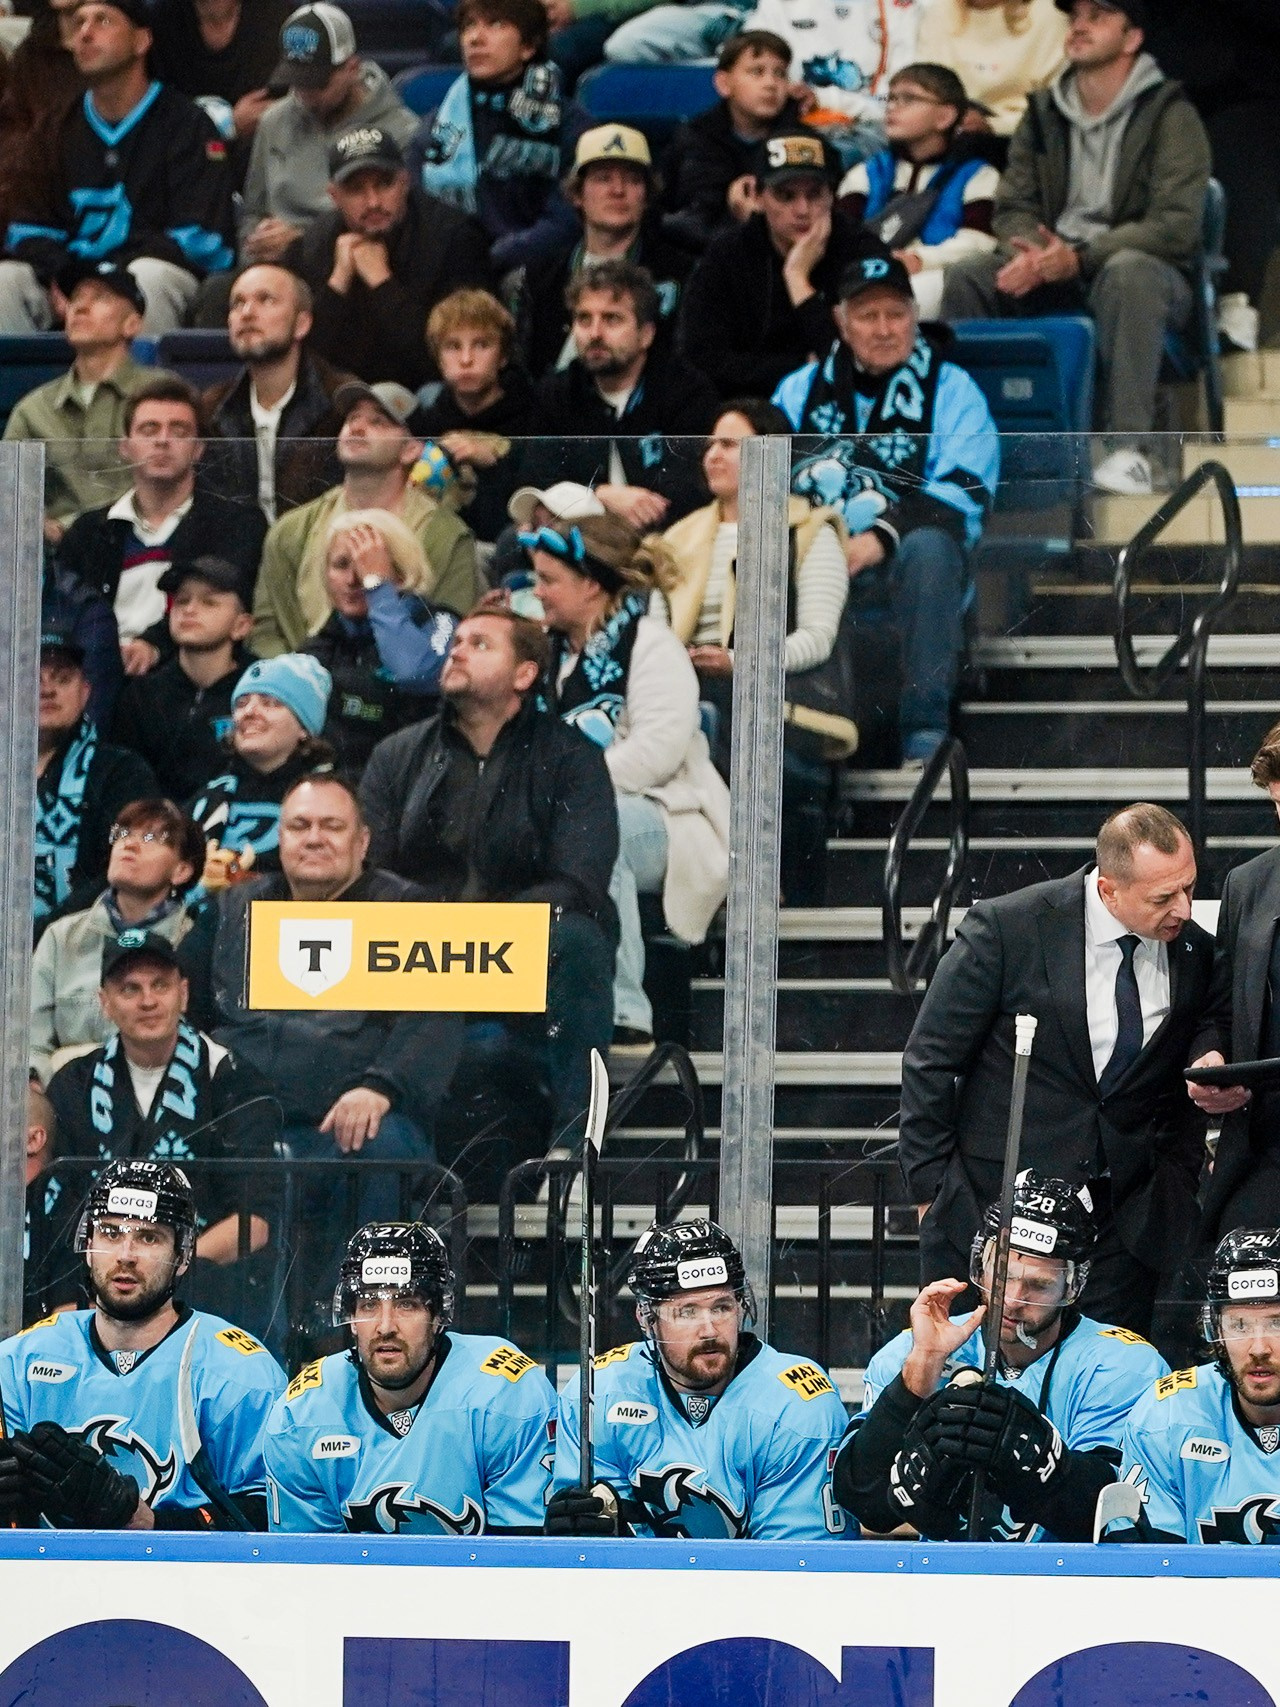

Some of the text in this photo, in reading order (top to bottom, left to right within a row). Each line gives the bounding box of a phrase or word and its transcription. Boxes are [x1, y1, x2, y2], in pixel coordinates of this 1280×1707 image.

[367, 941, 515, 974] БАНК
[130, 1161, 157, 1172] 80
[110, 1193, 154, 1209] согаз
[1028, 1194, 1056, 1214] 28
[379, 1226, 407, 1238] 27
[676, 1226, 703, 1240] 61
[1011, 1224, 1054, 1245] согаз
[1241, 1235, 1271, 1248] 24
[364, 1265, 409, 1276] согаз
[681, 1264, 724, 1280] согаз
[1230, 1277, 1275, 1290] согаз
[32, 1366, 63, 1378] МИР
[785, 1366, 820, 1384] MAX
[617, 1407, 649, 1419] МИР
[320, 1441, 352, 1452] МИР
[1190, 1443, 1223, 1458] МИР
